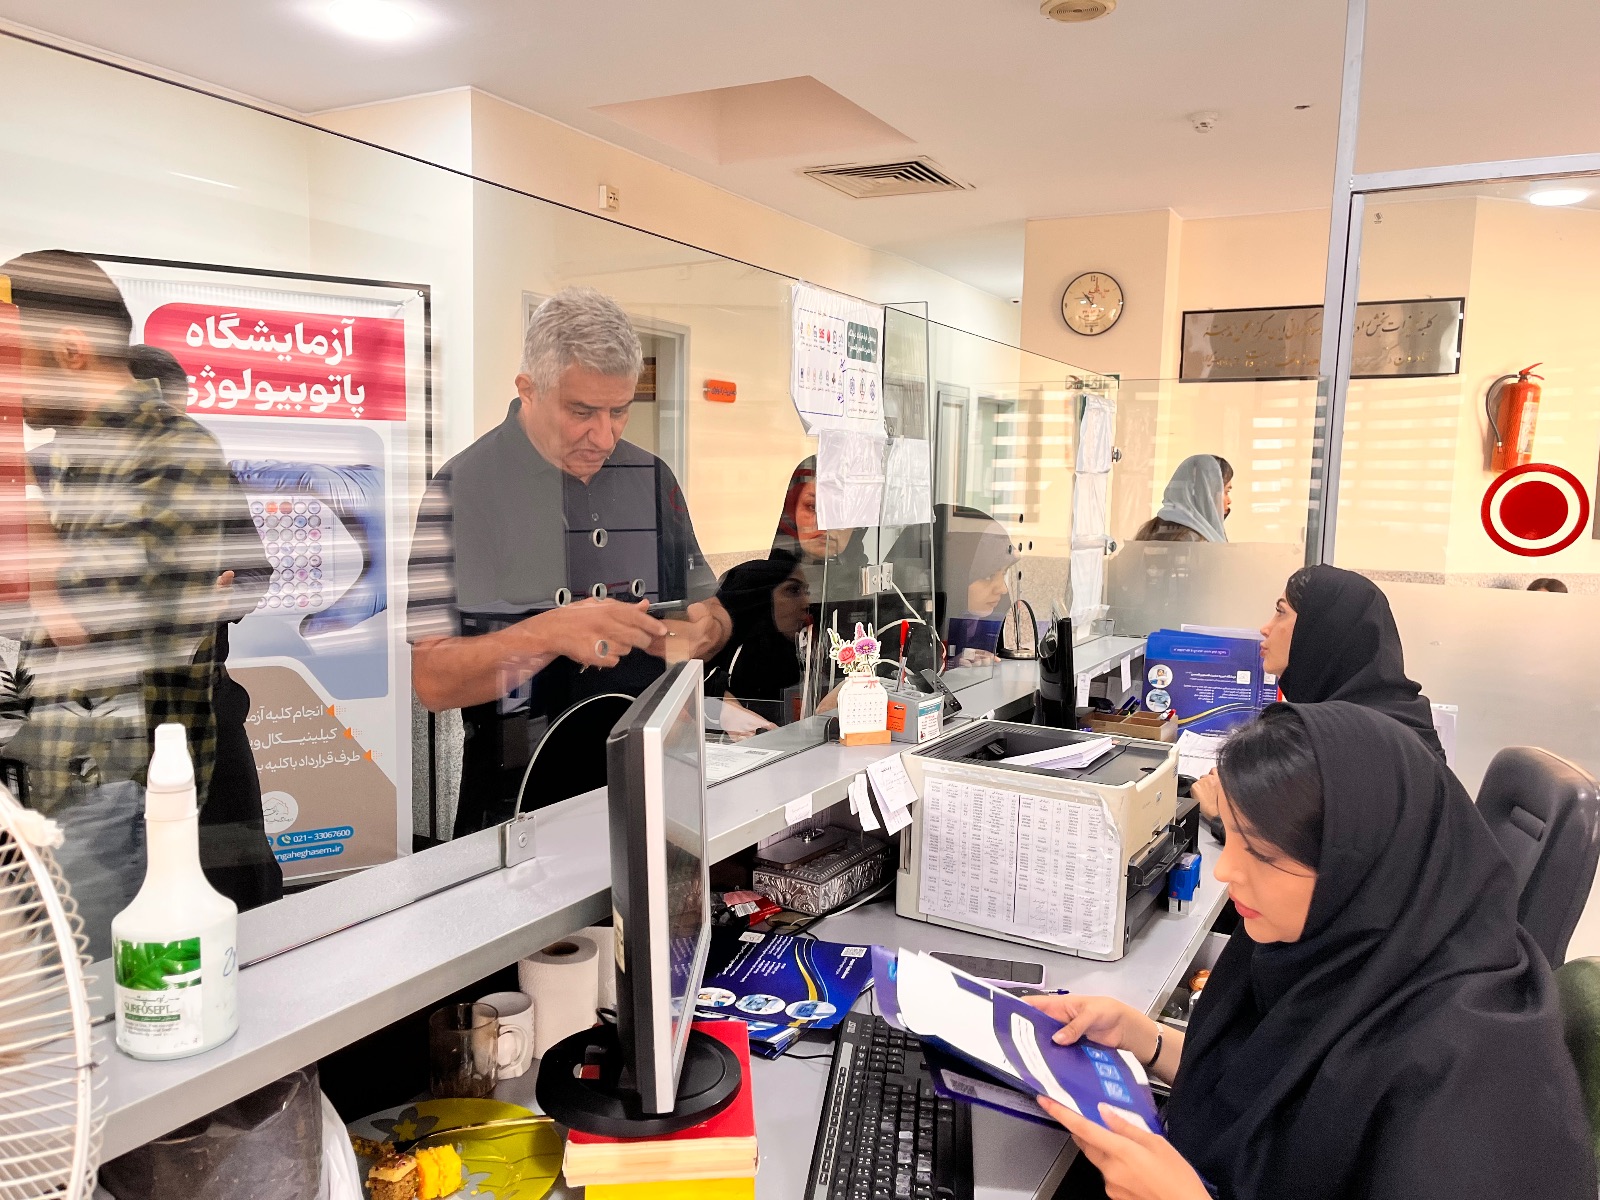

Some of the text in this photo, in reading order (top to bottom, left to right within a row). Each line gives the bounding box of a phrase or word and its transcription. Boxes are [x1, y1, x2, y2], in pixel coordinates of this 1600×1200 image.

[185, 312, 356, 366] آزمایشگاه
[265, 706, 293, 723] کلیه
[293, 704, 324, 723] انجام
[264, 757, 289, 772] کلیه
[289, 756, 298, 771] با
[298, 751, 334, 769] قرارداد
[334, 749, 361, 766] طرف
[292, 834, 307, 843] 021
[313, 828, 351, 841] 33067600
